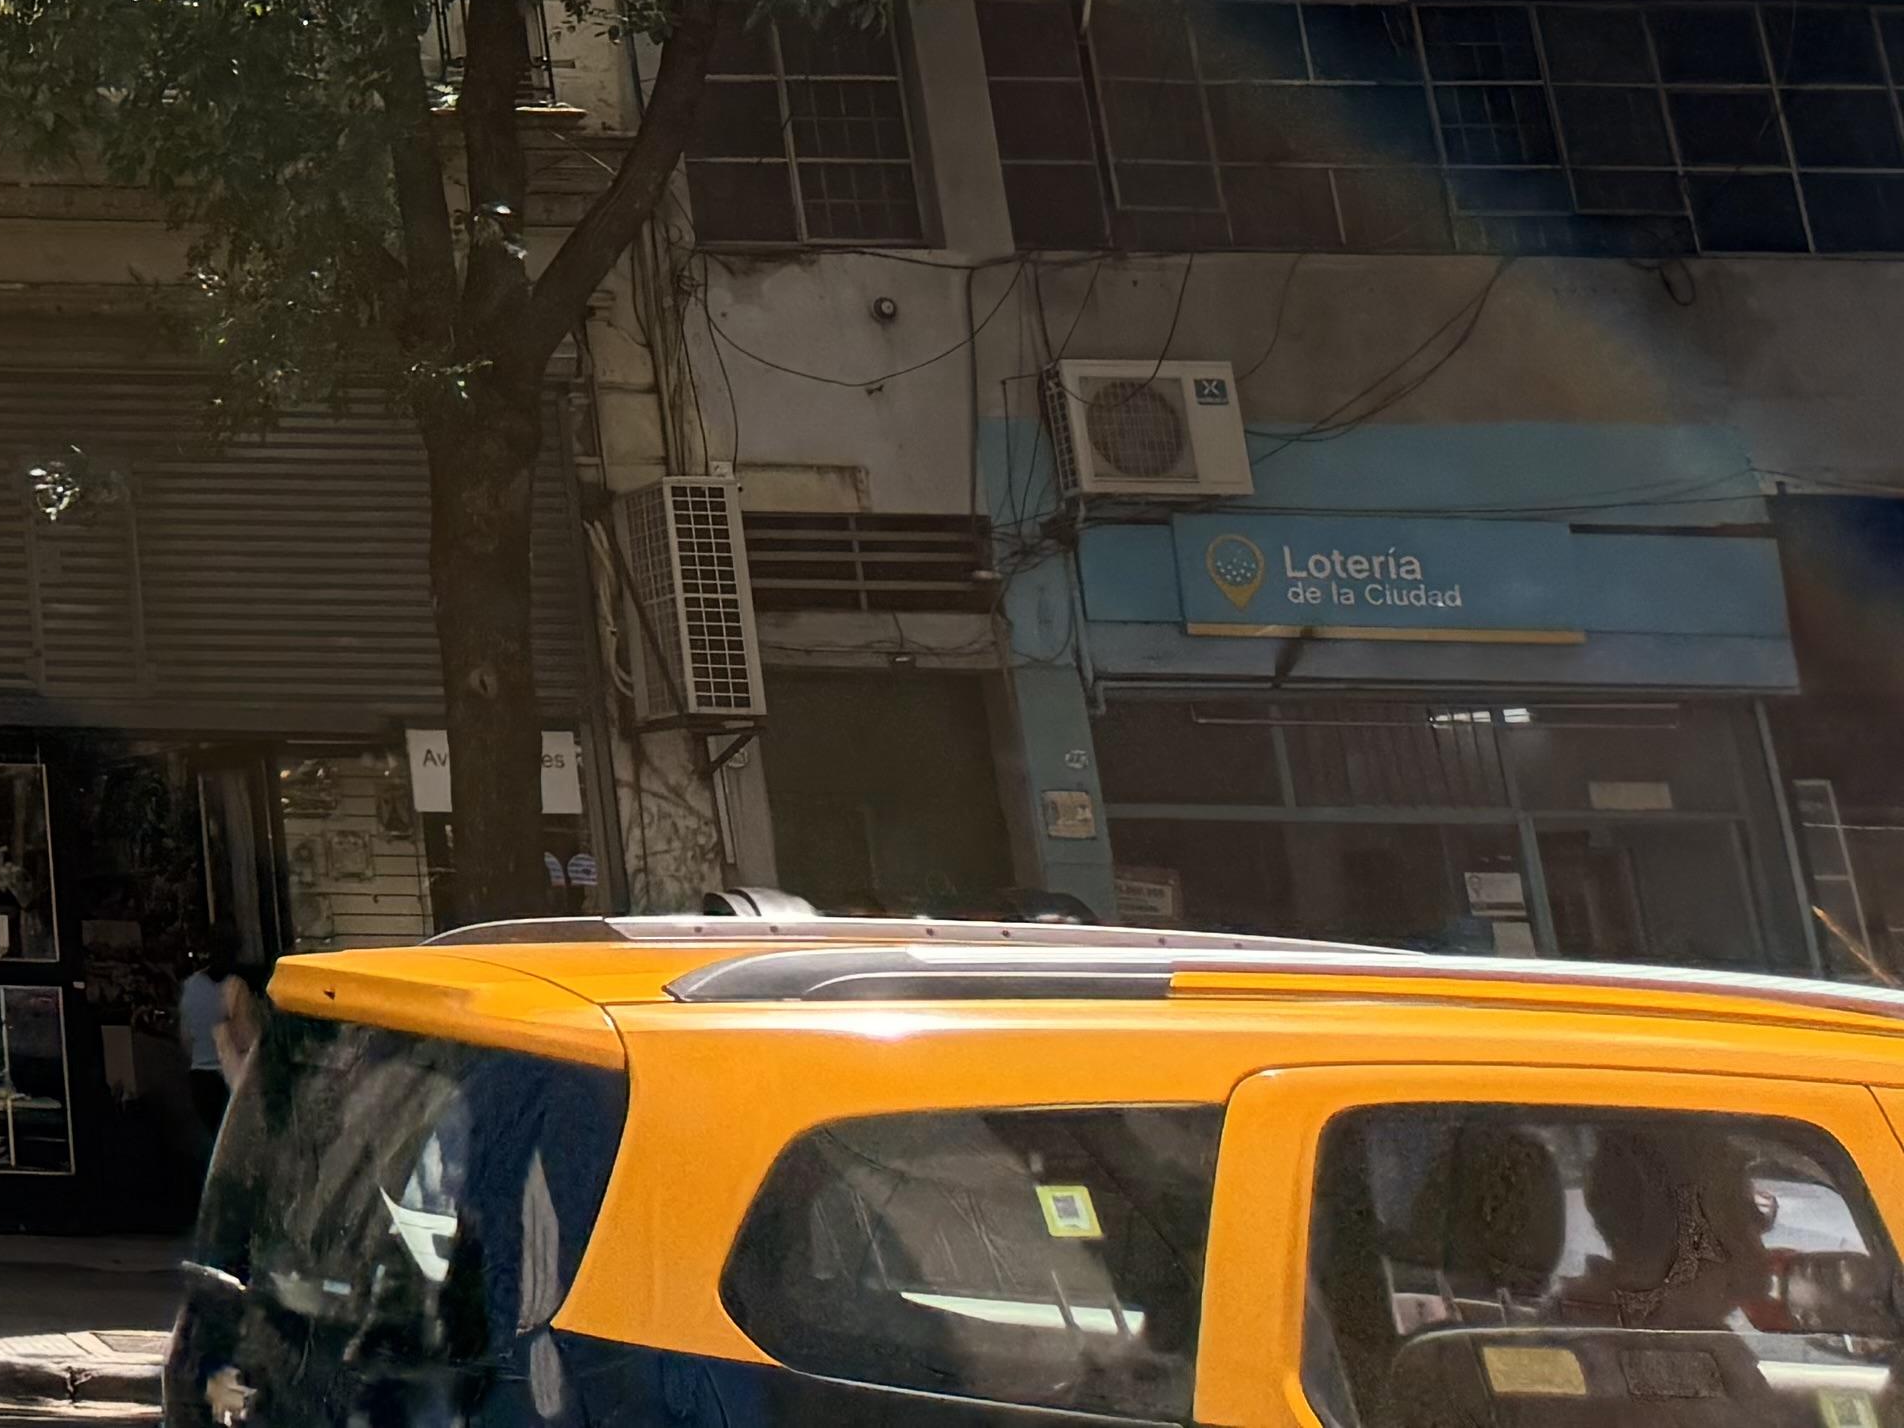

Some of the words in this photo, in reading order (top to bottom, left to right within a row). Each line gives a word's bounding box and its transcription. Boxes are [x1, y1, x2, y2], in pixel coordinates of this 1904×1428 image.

[1283, 545, 1424, 580] Lotería
[1287, 582, 1322, 604] de
[1331, 581, 1355, 605] la
[1364, 584, 1463, 607] Ciudad
